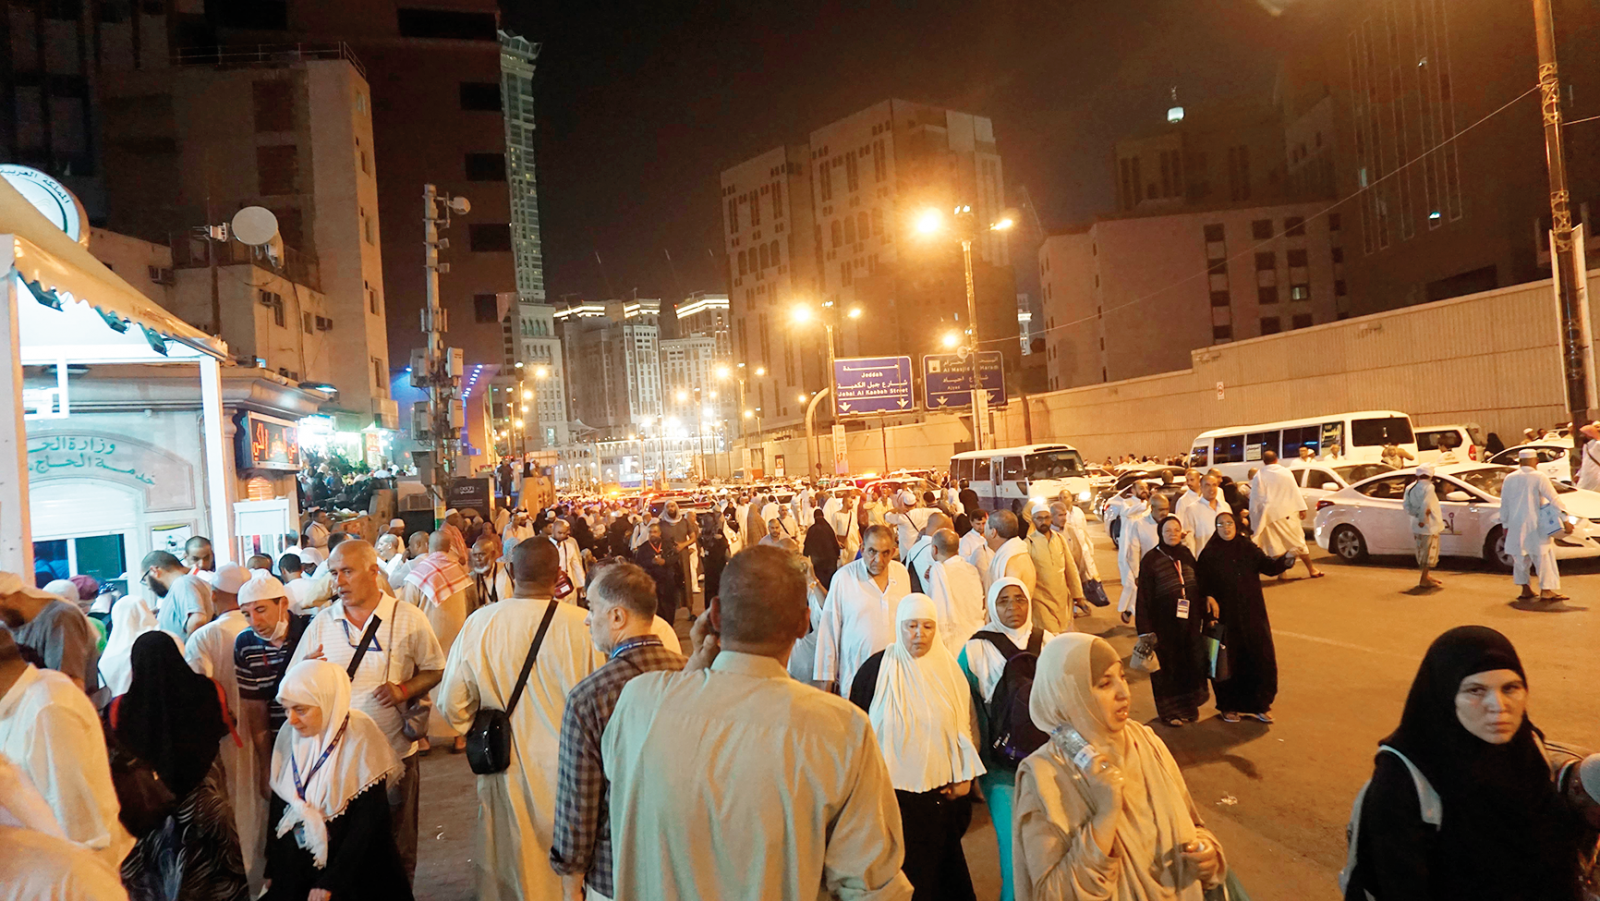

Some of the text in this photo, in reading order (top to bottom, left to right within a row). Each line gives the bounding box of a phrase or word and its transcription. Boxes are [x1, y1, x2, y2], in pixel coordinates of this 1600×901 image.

[882, 379, 908, 388] شارع
[28, 436, 116, 455] وزارة الح
[35, 453, 155, 485] خدمة الحاج
